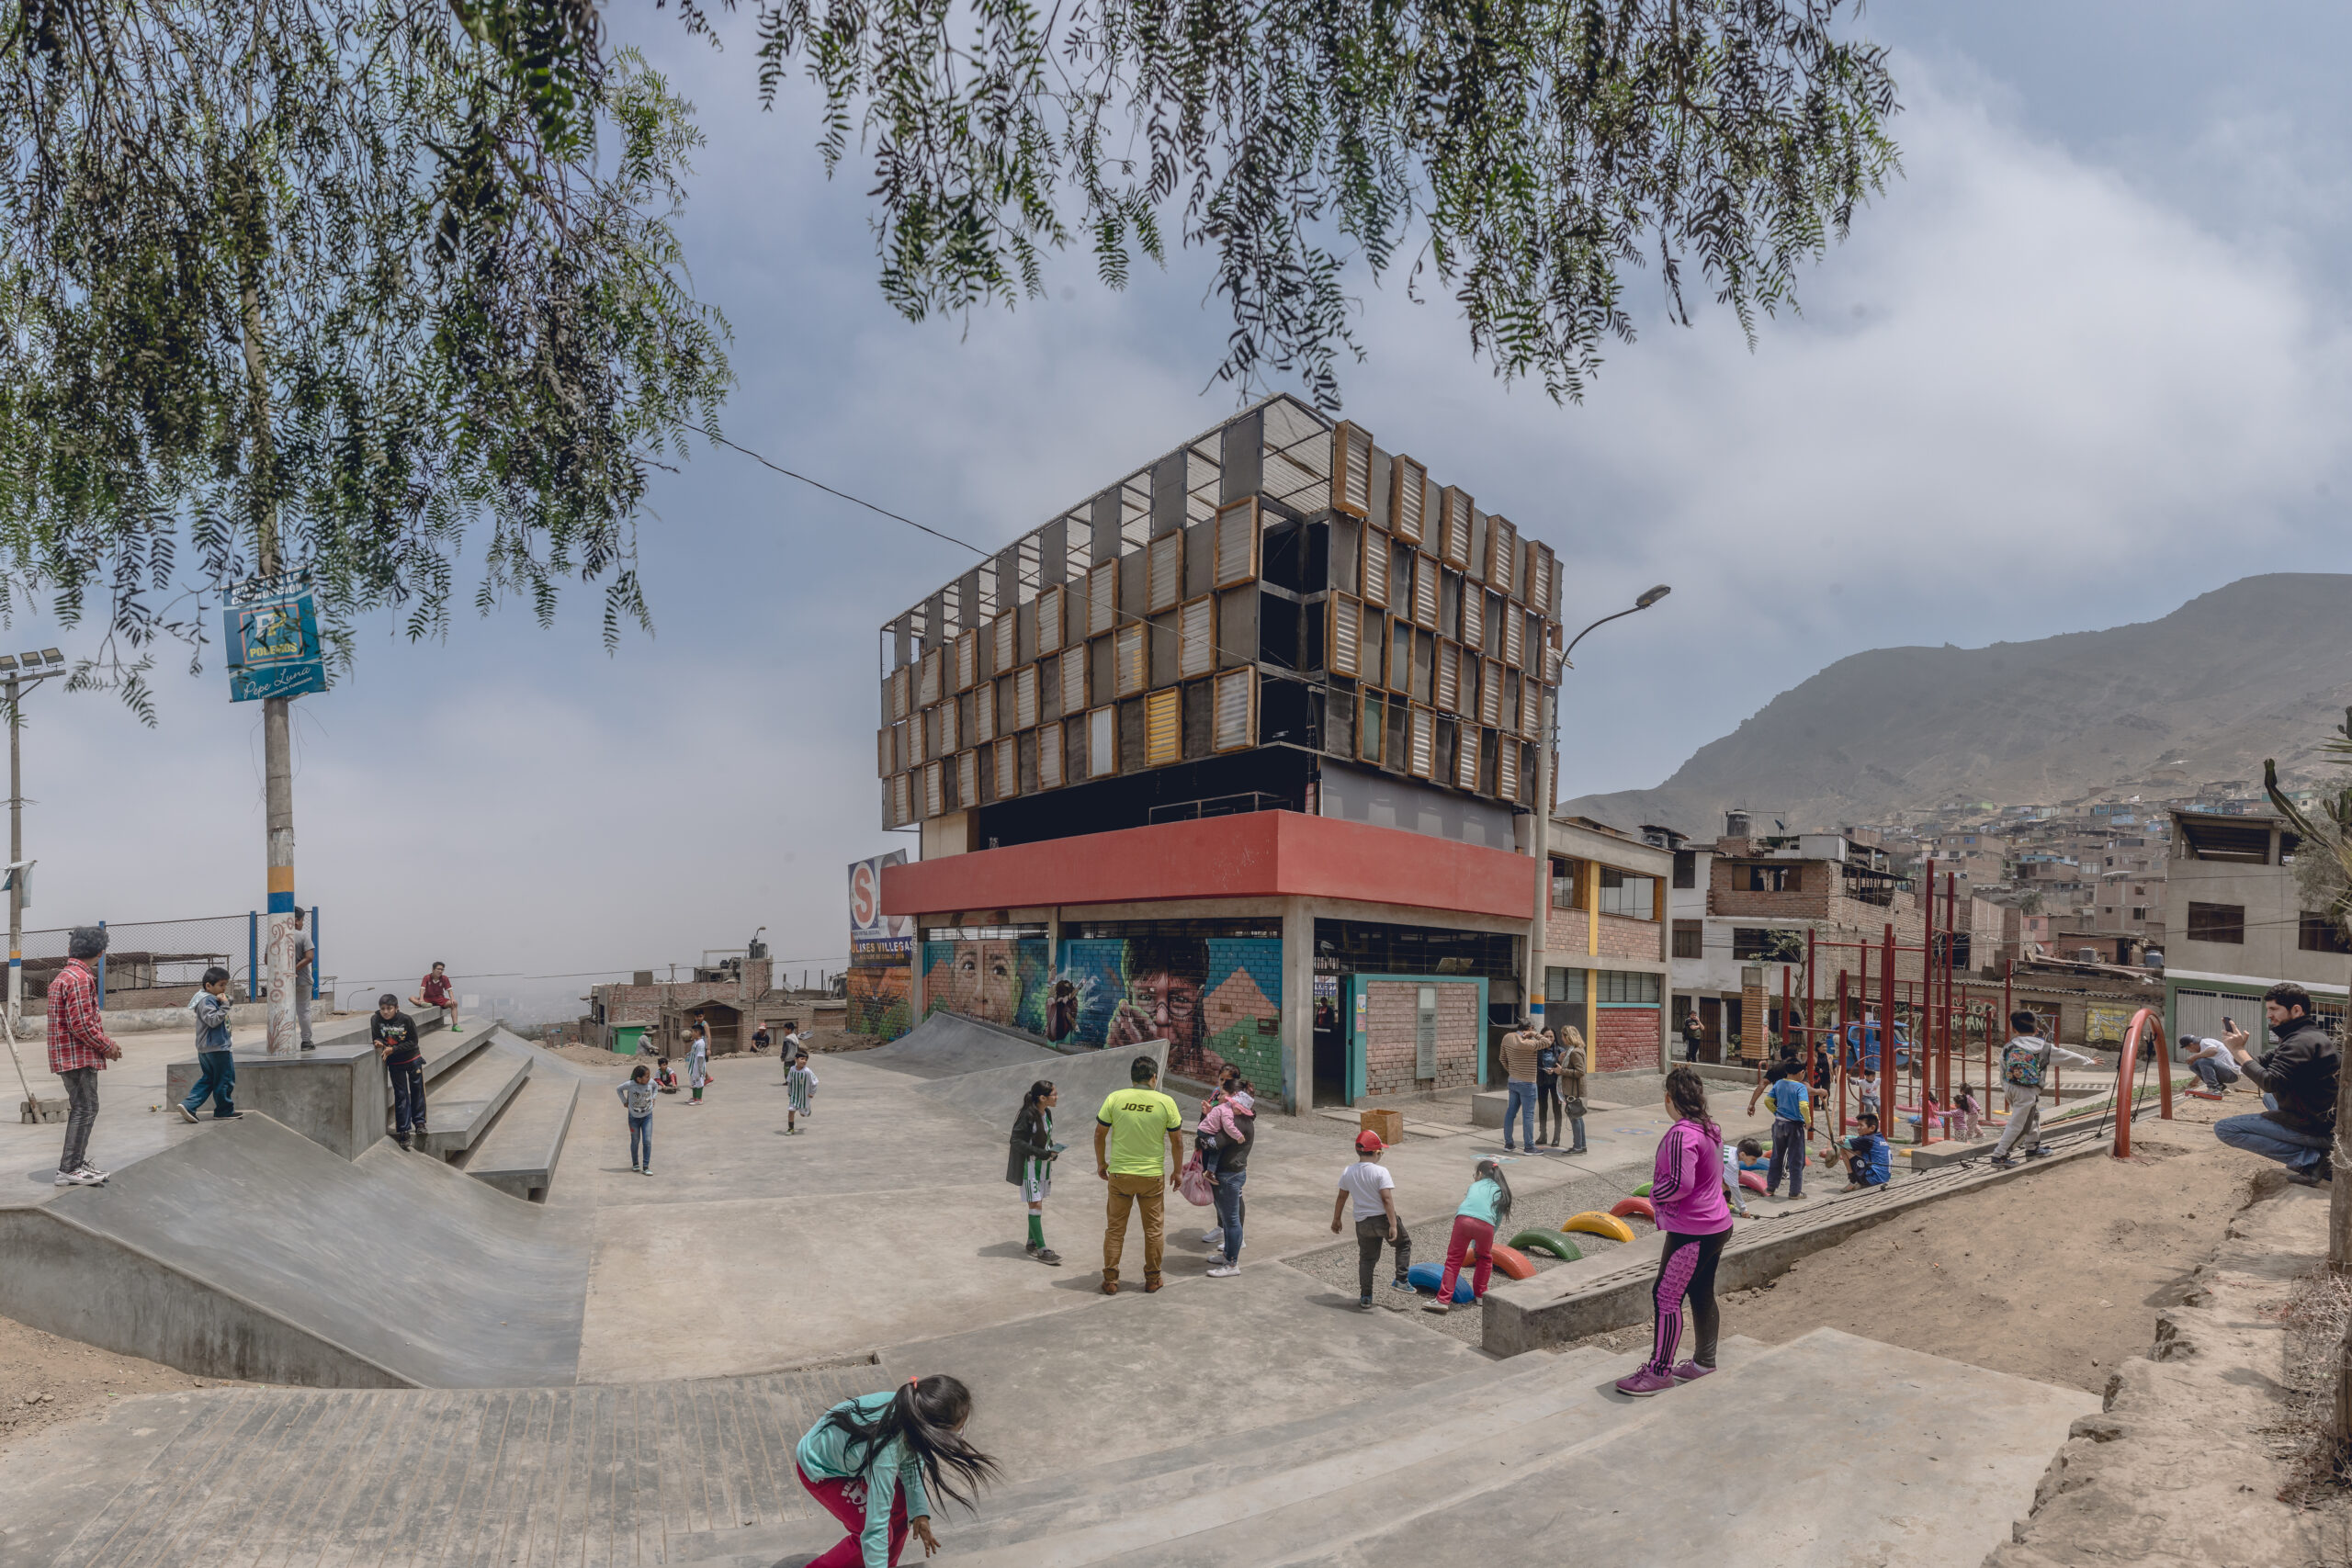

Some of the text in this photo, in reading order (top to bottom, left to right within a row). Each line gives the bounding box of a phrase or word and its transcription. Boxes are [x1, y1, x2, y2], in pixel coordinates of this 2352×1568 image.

[243, 667, 311, 700] Pepe Luna
[854, 867, 873, 923] S
[851, 942, 876, 953] ULISES
[1121, 1102, 1154, 1112] JOSE
